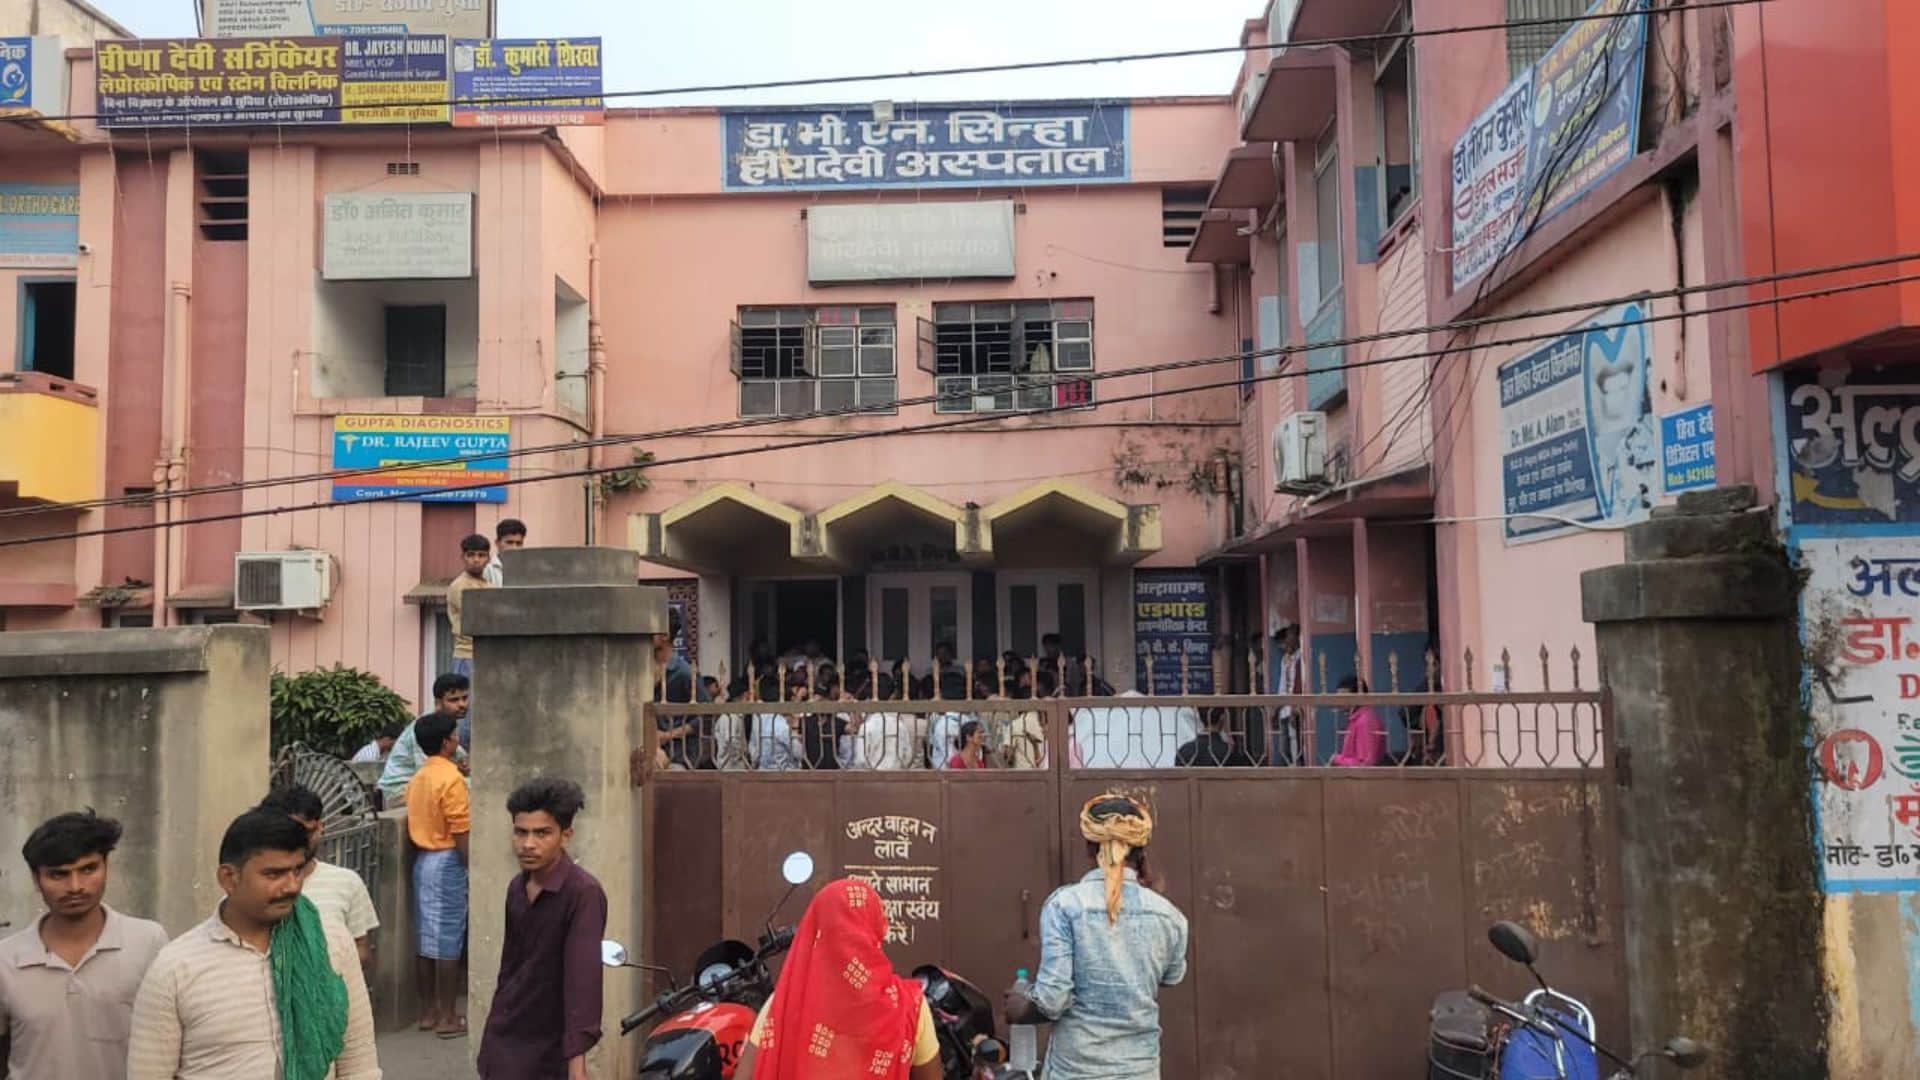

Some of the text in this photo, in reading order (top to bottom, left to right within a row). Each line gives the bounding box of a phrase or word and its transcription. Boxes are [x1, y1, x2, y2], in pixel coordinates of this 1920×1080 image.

[168, 42, 216, 71] देवी
[223, 40, 339, 69] सर्जिकेयर
[344, 39, 445, 56] DR. JAYESH KUMAR
[503, 40, 550, 75] कुमारी
[199, 72, 223, 92] एवं
[947, 110, 1091, 148] सिन्हा
[738, 146, 1113, 185] हीरादेवी अस्पताल
[345, 416, 504, 429] GUPTA DIAGNOSTICS
[361, 434, 507, 449] DR. RAJEEV GUPTA
[846, 815, 938, 845] अन्दर वाहन न
[885, 874, 933, 895] सामान
